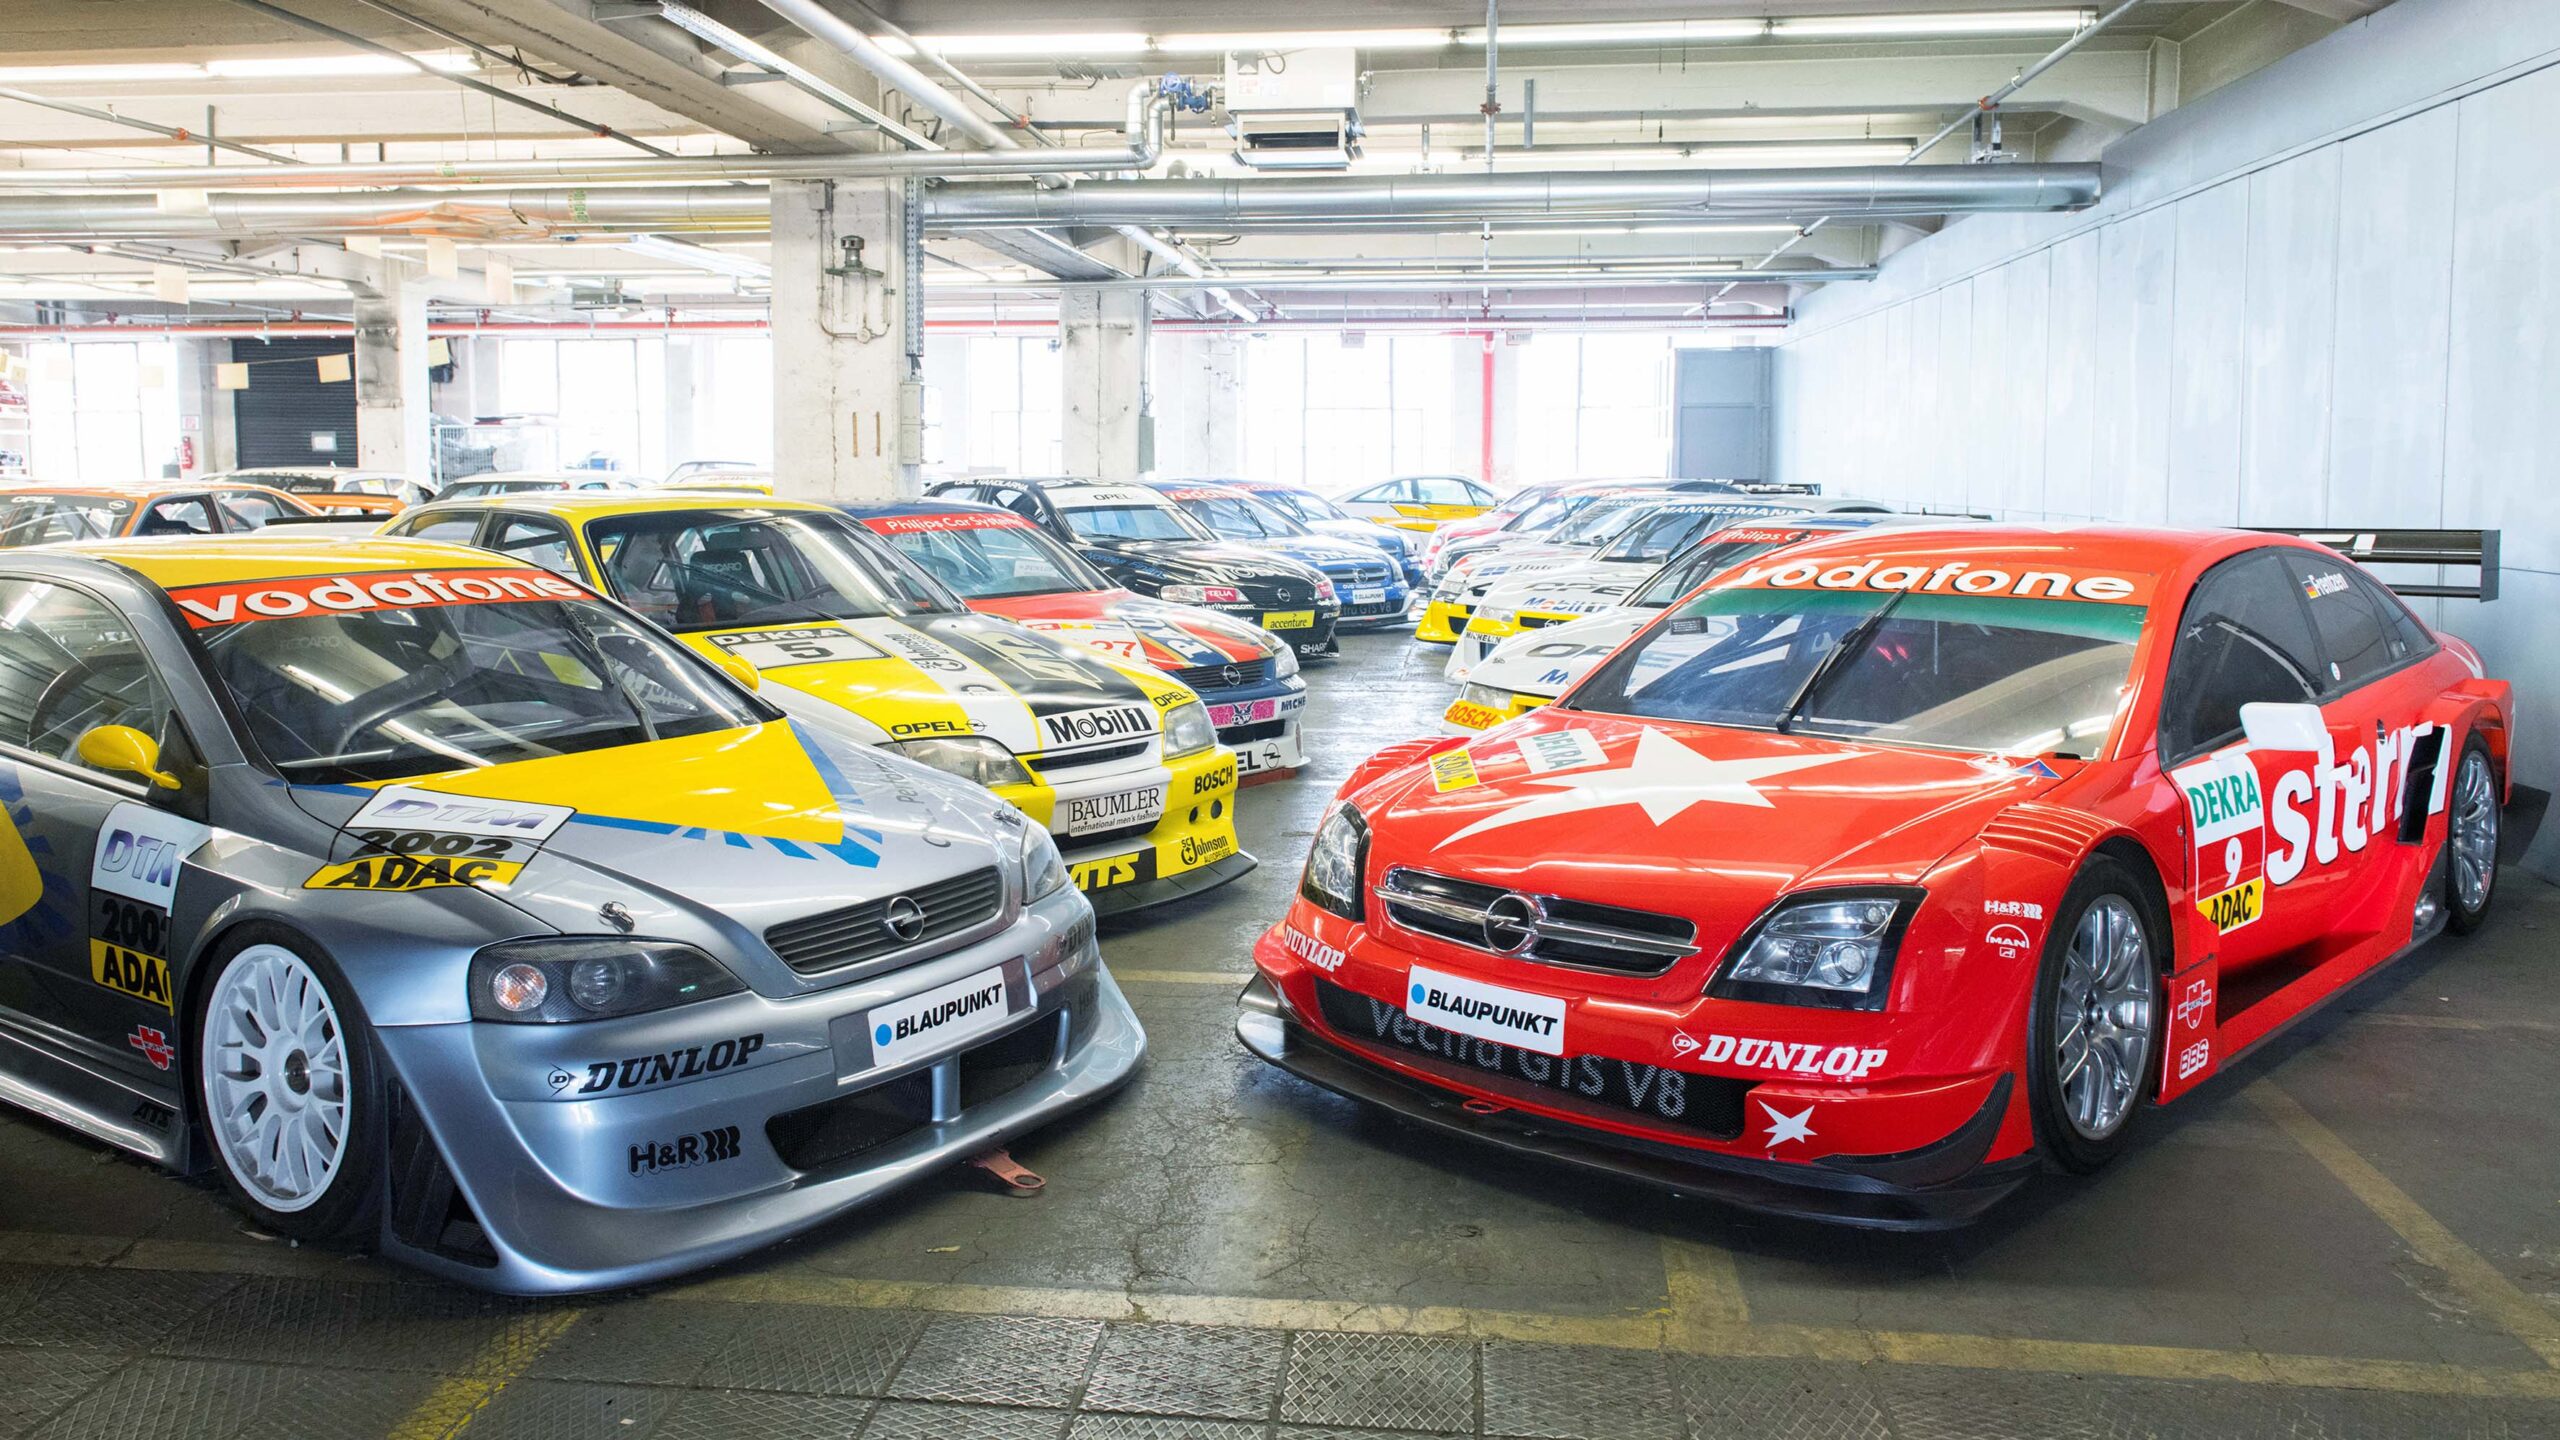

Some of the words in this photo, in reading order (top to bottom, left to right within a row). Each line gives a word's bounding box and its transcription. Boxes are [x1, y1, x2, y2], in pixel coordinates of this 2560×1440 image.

[1093, 493, 1132, 501] OPEL
[886, 518, 943, 530] Philips
[945, 517, 970, 527] Car
[177, 573, 581, 622] vodafone
[1740, 559, 2136, 600] vodafone
[711, 628, 849, 645] DEKRA
[1269, 618, 1308, 628] accenture
[775, 641, 834, 660] 5
[1153, 692, 1187, 707] OPEL
[1445, 704, 1498, 730] BOSCH
[891, 721, 965, 735] OPEL
[1044, 709, 1130, 744] Mobil
[1194, 765, 1233, 795] BOSCH
[371, 799, 548, 829] DTM
[1071, 787, 1161, 823] BÄUMLER
[2186, 771, 2261, 830] DEKRA
[1071, 820, 1115, 835] international
[1137, 809, 1160, 821] fashion
[348, 830, 513, 859] 2002
[2224, 837, 2243, 888] 9
[326, 858, 498, 889] ADAC
[2210, 884, 2254, 932] ADAC
[101, 898, 168, 955] 200
[1989, 936, 2027, 949] MAN
[1283, 925, 1346, 973] DUNLOP
[103, 946, 171, 1002] ADA
[895, 983, 1002, 1041] BLAUPUNKT
[1427, 988, 1558, 1037] BLAUPUNKT
[577, 1032, 765, 1094] DUNLOP
[1698, 1034, 1888, 1078] DUNLOP
[2178, 1038, 2210, 1081] BBS
[1621, 1060, 1686, 1118] V8
[629, 1134, 701, 1173] H&R
